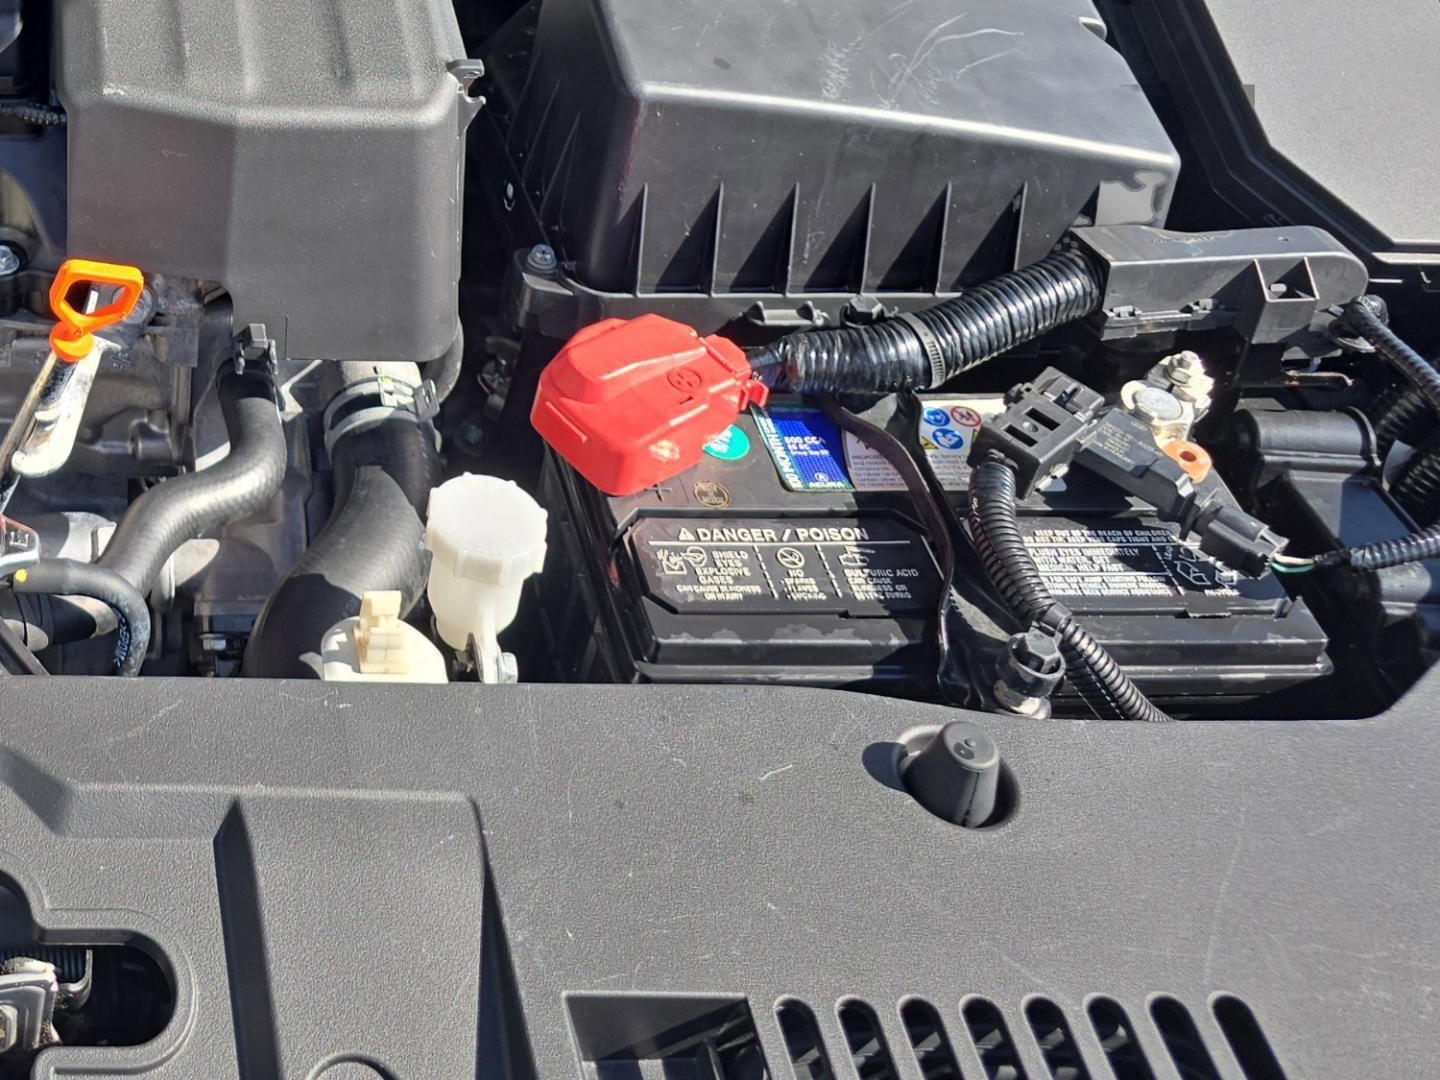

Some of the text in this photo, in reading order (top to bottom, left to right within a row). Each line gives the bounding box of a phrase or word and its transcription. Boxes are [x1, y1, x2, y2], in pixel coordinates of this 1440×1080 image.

[696, 528, 869, 541] DANGER / POISON
[712, 550, 749, 559] SHIELD
[1081, 548, 1140, 556] IMMEDIATELY
[715, 559, 743, 568] EYES
[695, 567, 752, 576] EXPLOSIVE
[788, 569, 804, 578] NO
[844, 568, 919, 578] SULFURIC ACID
[698, 575, 734, 584] GASES
